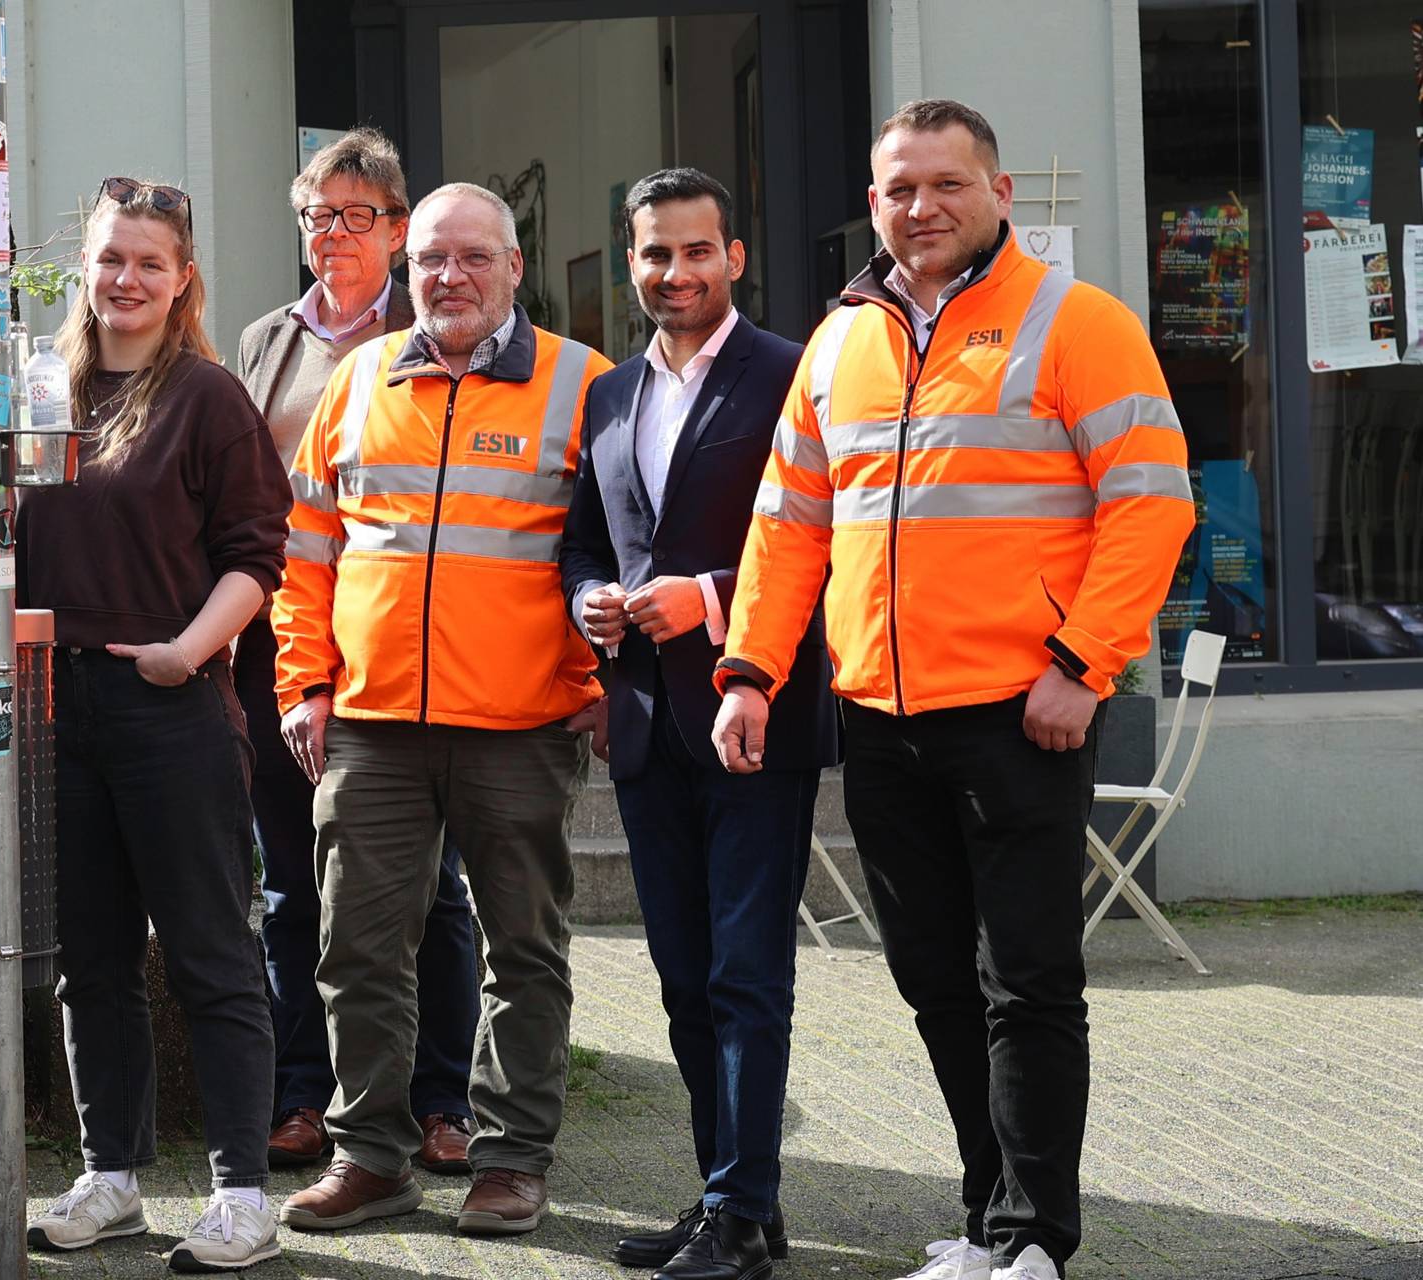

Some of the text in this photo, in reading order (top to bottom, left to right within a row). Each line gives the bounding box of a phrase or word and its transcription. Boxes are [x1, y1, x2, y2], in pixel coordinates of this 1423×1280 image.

[1321, 153, 1354, 165] BACH
[1307, 163, 1370, 176] JOHANNES-
[1303, 173, 1355, 185] PASSION
